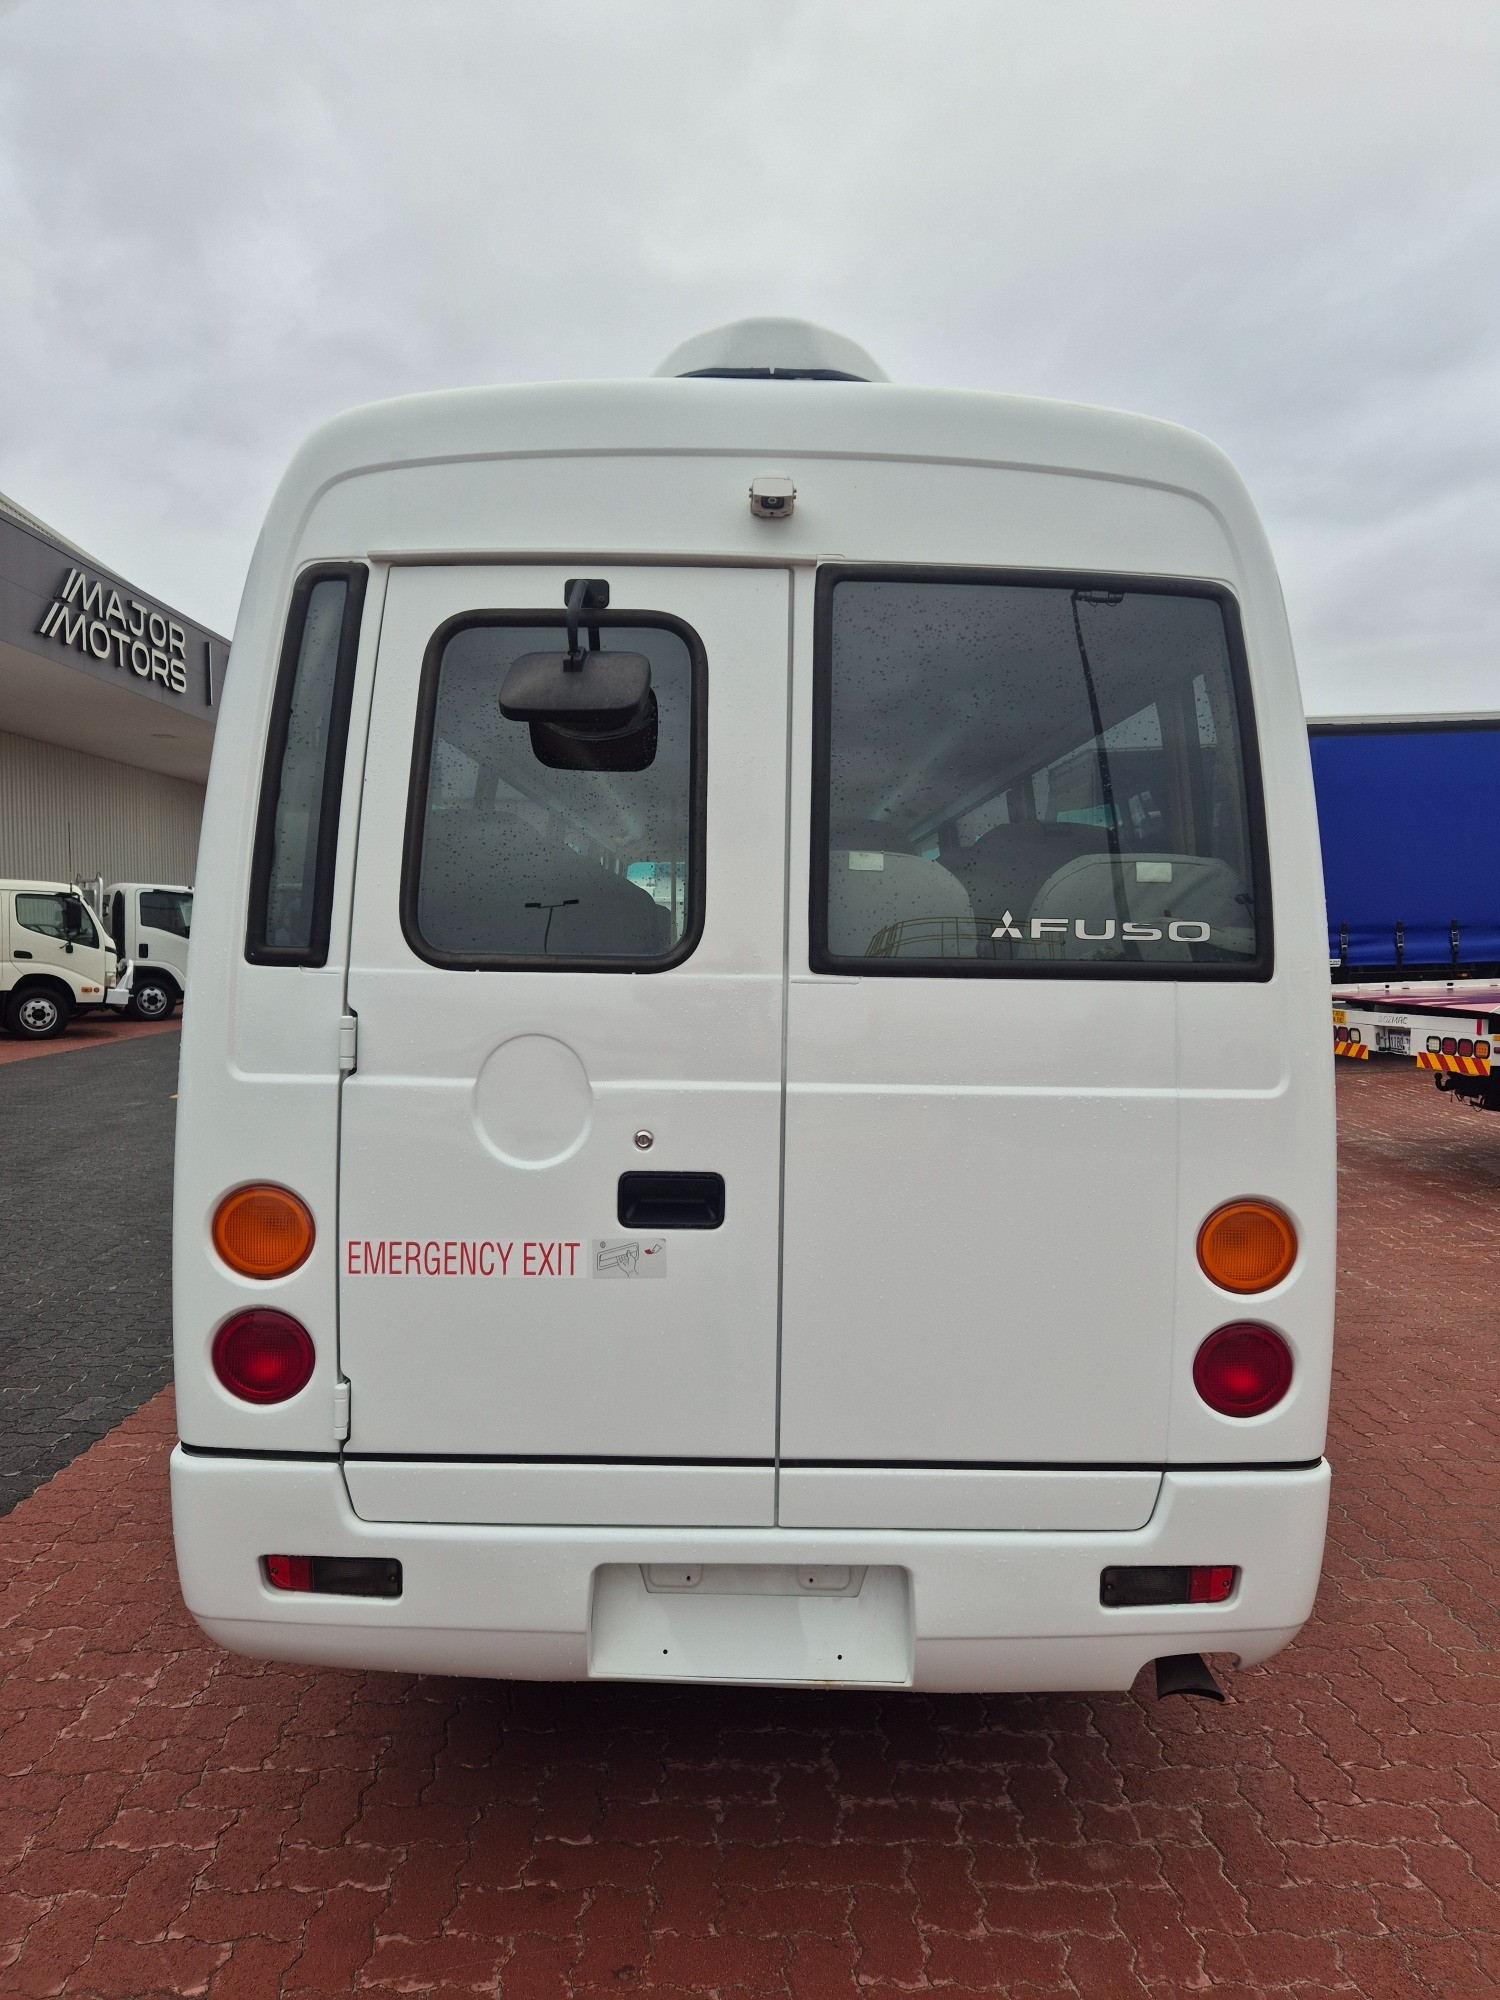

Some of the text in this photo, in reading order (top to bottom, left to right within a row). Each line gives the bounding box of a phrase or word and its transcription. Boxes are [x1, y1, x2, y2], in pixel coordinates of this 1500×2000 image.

[1030, 918, 1211, 942] FUSO
[348, 1241, 581, 1276] EMERGENCY EXIT
